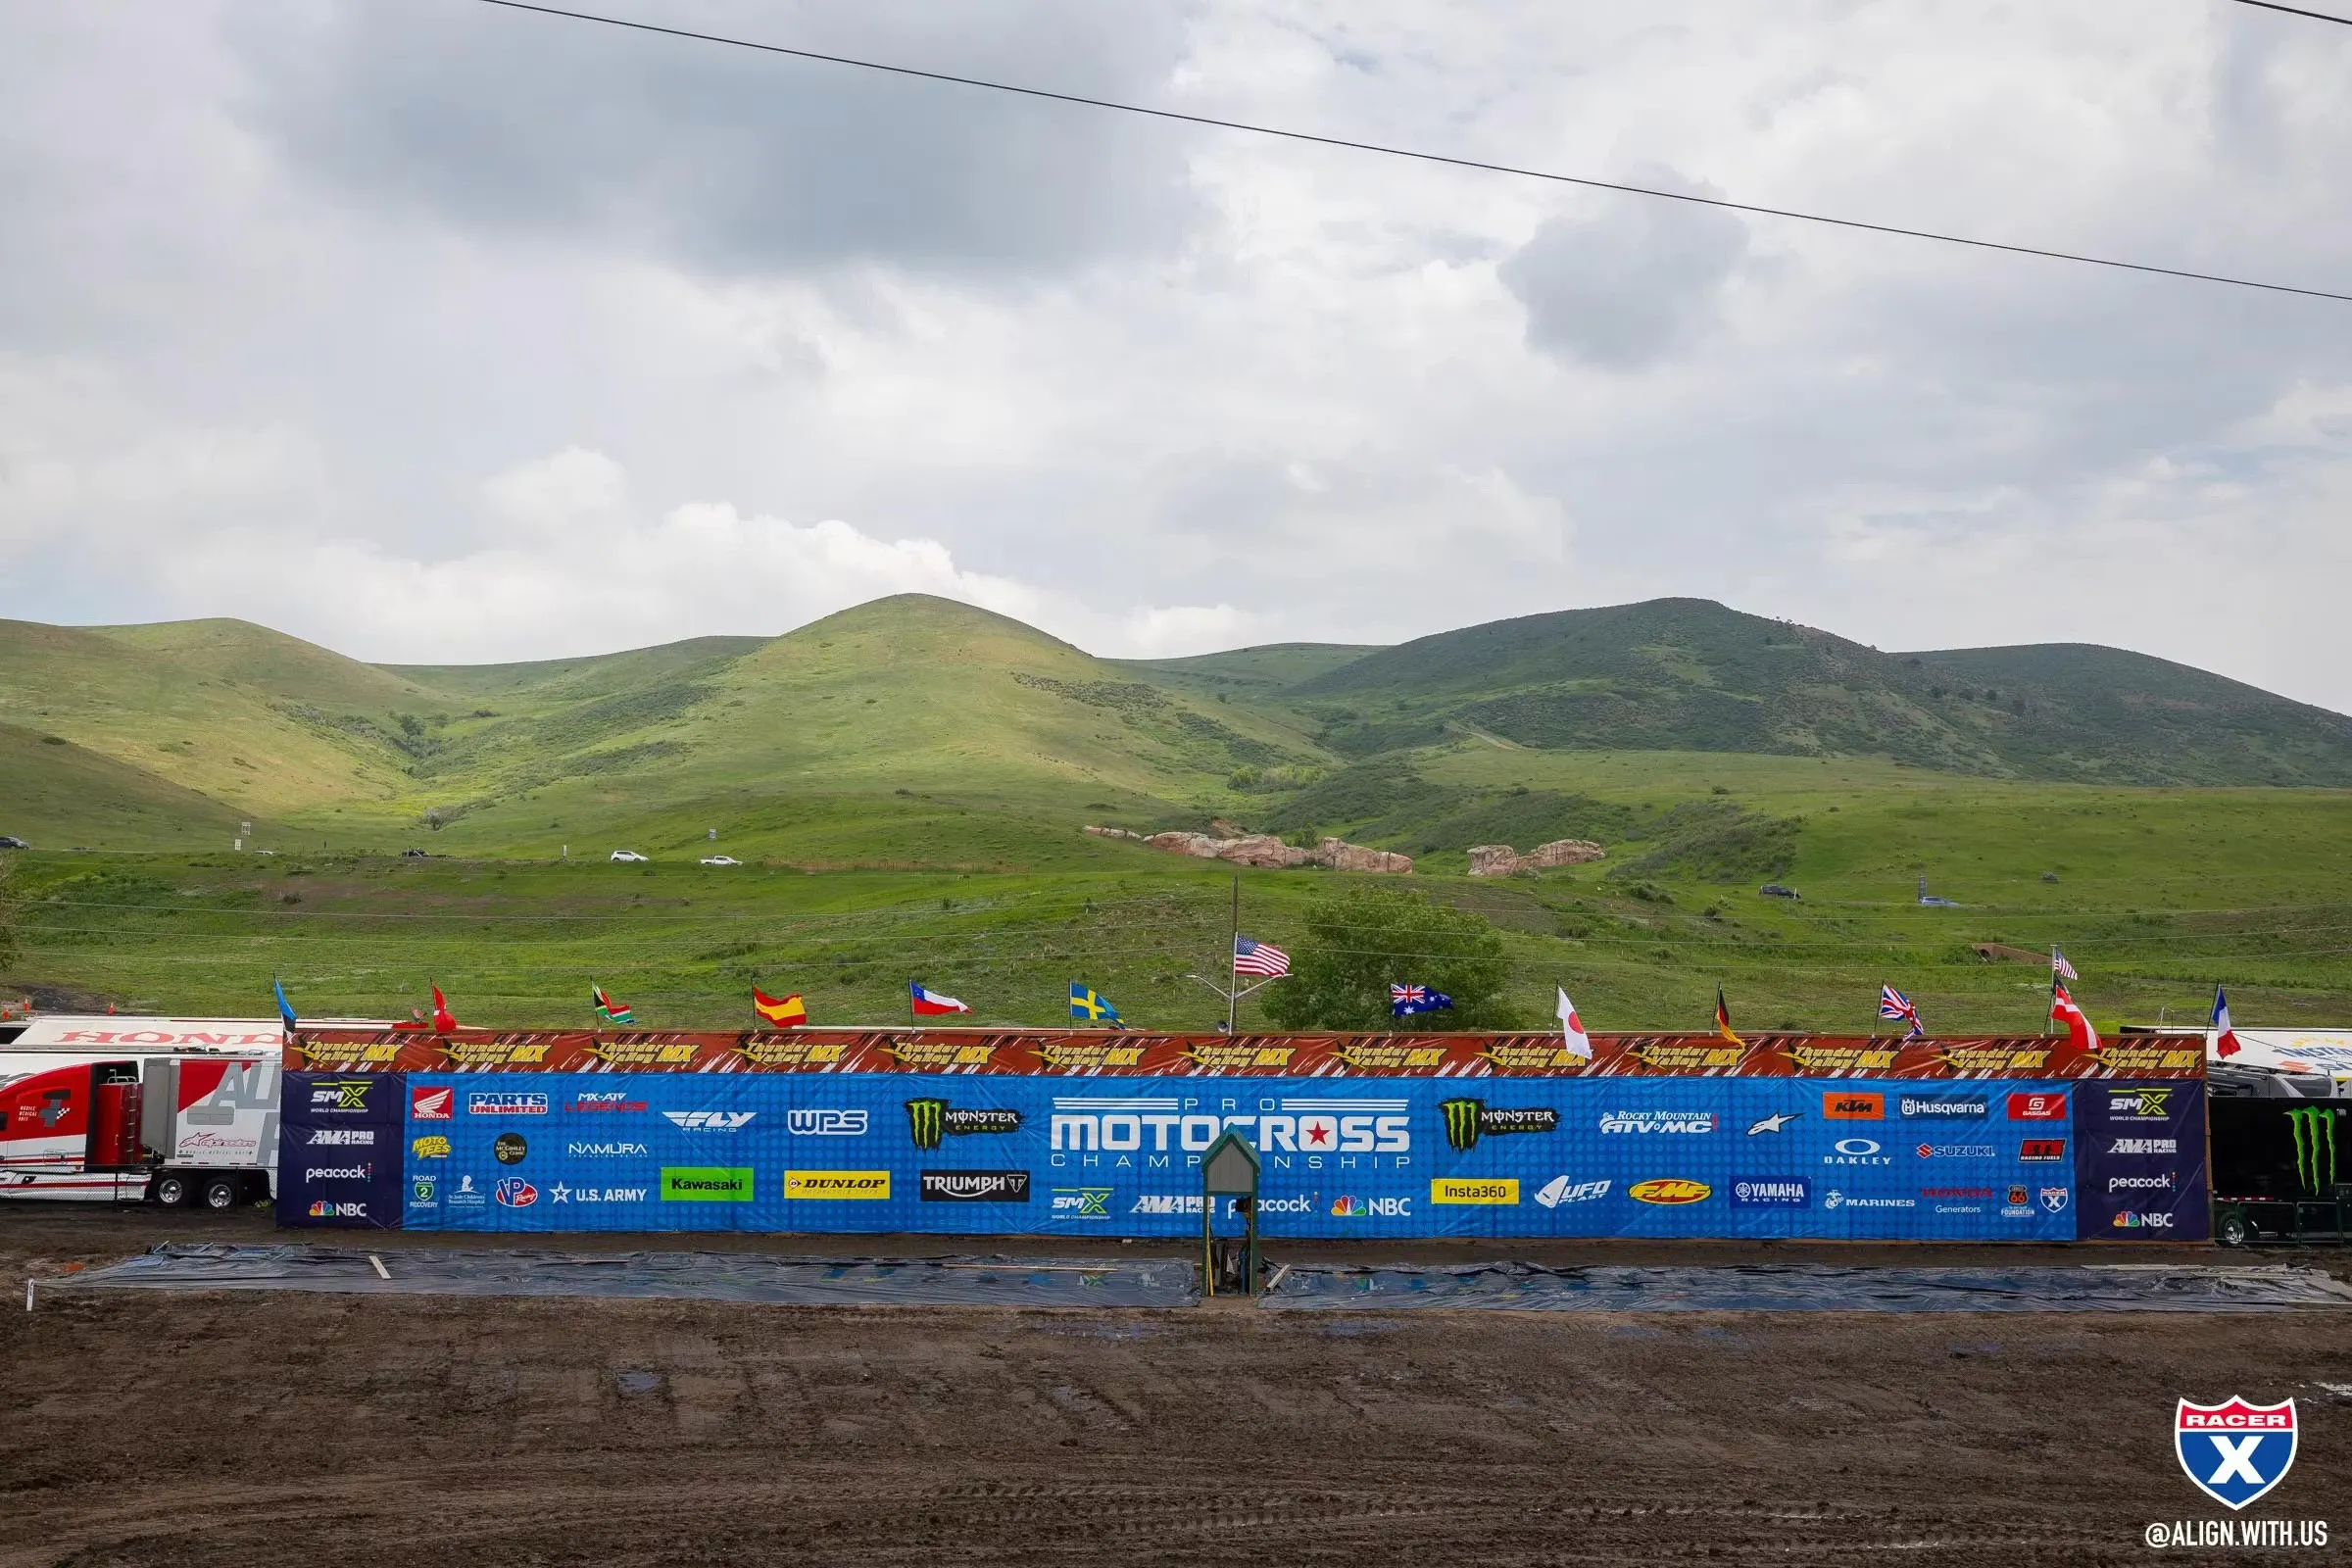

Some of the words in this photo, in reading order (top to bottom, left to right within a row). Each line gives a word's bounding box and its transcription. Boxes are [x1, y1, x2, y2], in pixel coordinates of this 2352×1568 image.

[53, 1030, 282, 1045] HOND
[305, 1042, 368, 1051] Thunder
[314, 1052, 360, 1062] Valley
[361, 1044, 404, 1061] MX
[448, 1043, 515, 1052] Thunder
[599, 1043, 664, 1052] Thunder
[745, 1043, 811, 1052] Thunder
[895, 1042, 960, 1053] Thunder
[1044, 1046, 1109, 1055] Thunder
[1194, 1047, 1257, 1055] Thunder
[1344, 1047, 1409, 1056] Thunder
[1490, 1047, 1557, 1056] Thunder
[1642, 1046, 1706, 1055] Thunder
[1795, 1047, 1863, 1056] Thunder
[2099, 1048, 2167, 1058] Thunder
[459, 1053, 507, 1063] Valley
[508, 1045, 551, 1062] MX
[610, 1052, 657, 1063] Valley
[656, 1045, 699, 1061] MX
[756, 1052, 805, 1063] Valley
[805, 1045, 848, 1061] MX
[905, 1053, 953, 1064] Valley
[954, 1046, 996, 1063] MX
[1054, 1055, 1102, 1066] Valley
[1102, 1049, 1146, 1065] MX
[1204, 1055, 1250, 1066] Valley
[1251, 1049, 1296, 1065] MX
[1352, 1056, 1401, 1067] Valley
[1403, 1049, 1446, 1065] MX
[1652, 1055, 1700, 1068] Valley
[1701, 1049, 1745, 1066] MX
[1804, 1056, 1853, 1069] Valley
[1853, 1051, 1899, 1068] MX
[1947, 1049, 2016, 1058] Thunder
[2109, 1058, 2158, 1069] Valley
[2159, 1050, 2202, 1068] MX
[1500, 1056, 1549, 1067] Valley
[1957, 1058, 2006, 1070] Valley
[2007, 1051, 2050, 1068] MX
[311, 1086, 368, 1107] SMX
[470, 1094, 547, 1105] PARTS
[577, 1093, 627, 1102] MX-ATV
[564, 1100, 648, 1112] LEGENDS
[1185, 1098, 1275, 1110] PRO
[1835, 1100, 1873, 1113] KTM
[1916, 1102, 1984, 1114] Husqvarna
[2109, 1094, 2170, 1115] SMX
[662, 1111, 758, 1127] FLY
[945, 1110, 1018, 1123] MONSTER
[1481, 1110, 1555, 1123] MONSTER
[1617, 1110, 1652, 1120] ROCKY
[1653, 1111, 1711, 1120] MOUNTAIN
[788, 1109, 868, 1136] WPS
[306, 1130, 350, 1145] AMA
[351, 1131, 374, 1140] PRO
[413, 1137, 447, 1152] MOTO
[568, 1141, 648, 1153] NAMURA
[1934, 1146, 1993, 1156] SUZUKI
[2107, 1139, 2153, 1153] AMA
[2153, 1140, 2177, 1149] PRO
[417, 1145, 451, 1160] TEES
[1051, 1154, 1410, 1168] CHAMPNSHIP
[306, 1164, 366, 1183] peacock
[671, 1178, 743, 1191] Kawasaki
[804, 1179, 886, 1188] DUNLOP
[923, 1176, 1004, 1197] TRIUMPH
[1561, 1180, 1611, 1199] UFO
[1630, 1182, 1710, 1198] FMF
[2109, 1174, 2170, 1193] peacock
[419, 1187, 428, 1198] 2
[496, 1176, 526, 1206] VP
[576, 1189, 601, 1201] U.S.
[604, 1189, 647, 1201] ARMY
[1445, 1185, 1506, 1198] Insta360
[1750, 1183, 1804, 1198] YAMAHA
[1922, 1188, 1993, 1198] HONDA
[2010, 1192, 2025, 1202] 66
[1052, 1193, 1109, 1213] SMX
[1129, 1196, 1184, 1213] AMA
[1559, 1194, 1606, 1203] PLAST
[1846, 1199, 1915, 1207] MARINES
[2047, 1196, 2061, 1207] X
[335, 1202, 367, 1216] NBC
[1228, 1194, 1311, 1219] pacock
[1368, 1198, 1411, 1216] NBC
[1936, 1204, 1981, 1213] Generators
[2141, 1213, 2173, 1227] NBC
